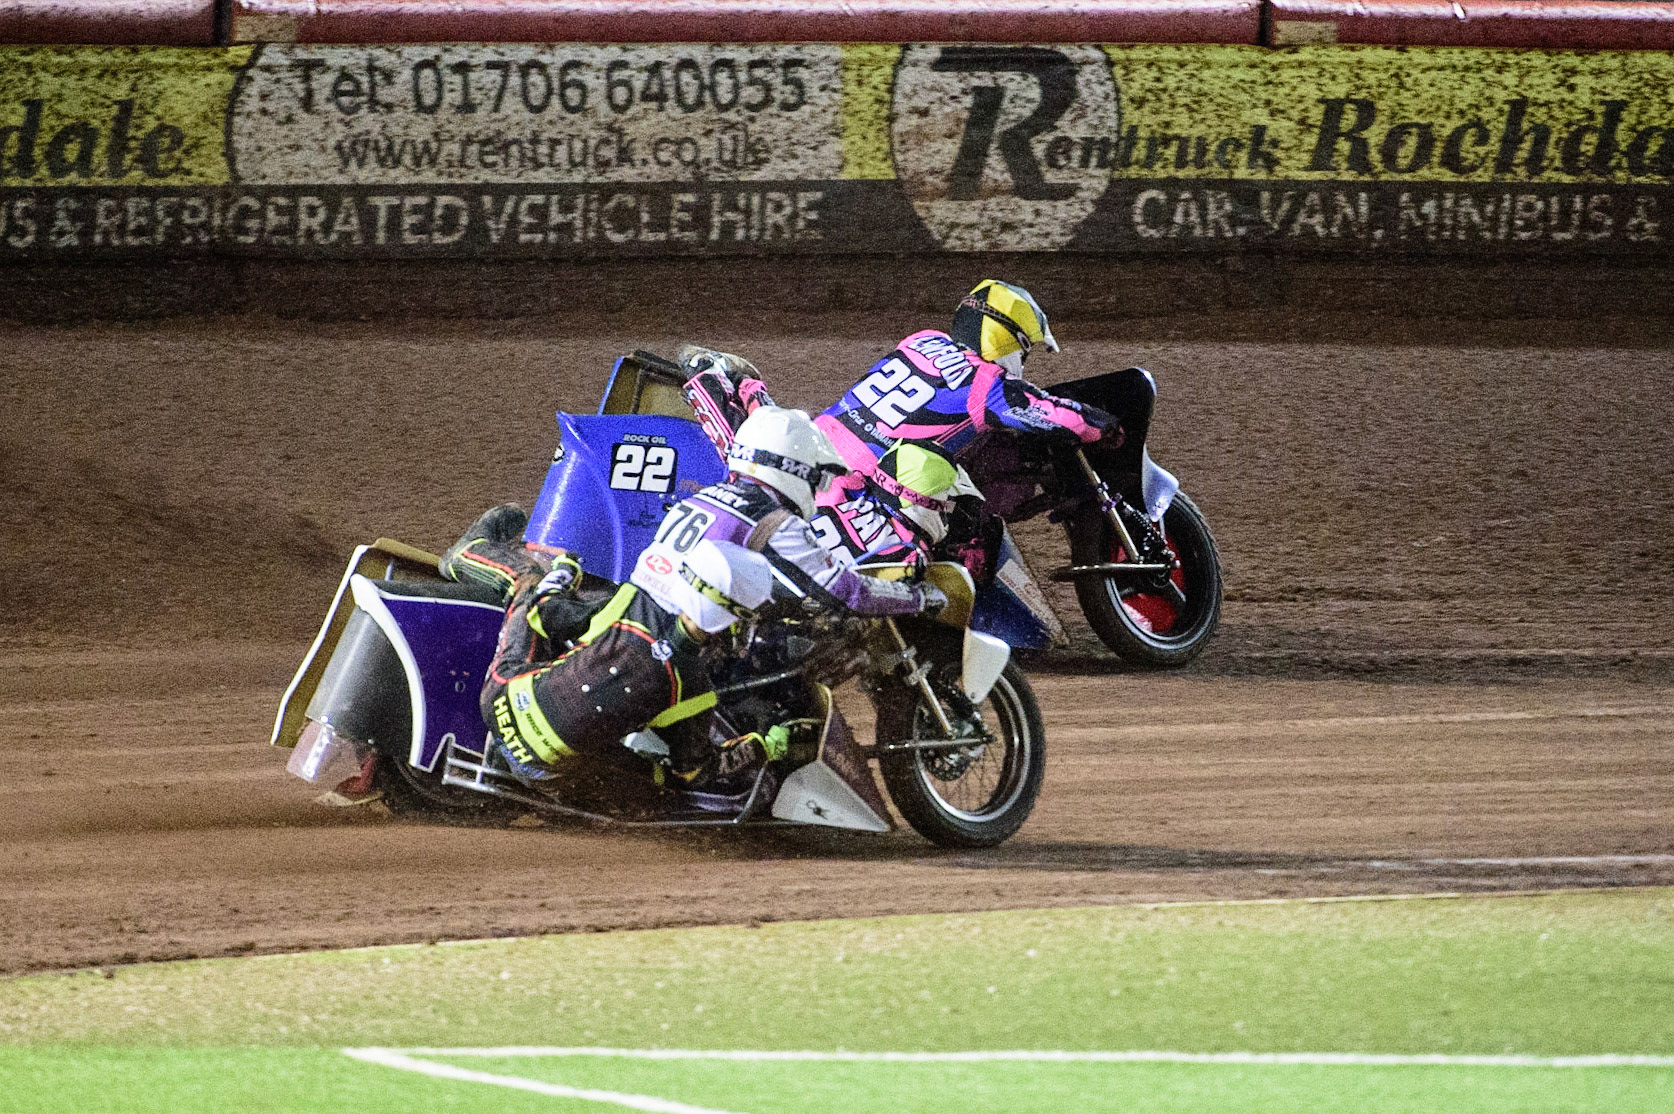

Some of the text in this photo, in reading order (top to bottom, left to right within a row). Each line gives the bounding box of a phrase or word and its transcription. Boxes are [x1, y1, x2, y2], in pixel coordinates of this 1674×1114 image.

[411, 58, 589, 115] 01706
[604, 57, 807, 115] 640055
[0, 98, 192, 180] dale
[0, 198, 38, 248] S
[49, 198, 86, 248] &
[94, 194, 470, 247] REFRIGERATED
[481, 192, 699, 243] VEHICLE
[1399, 191, 1614, 241] MINIBUS
[852, 357, 936, 429] 22
[623, 433, 667, 445] ROCK OIL
[610, 444, 675, 493] 22
[659, 504, 709, 553] 76
[493, 695, 533, 764] HEATH
